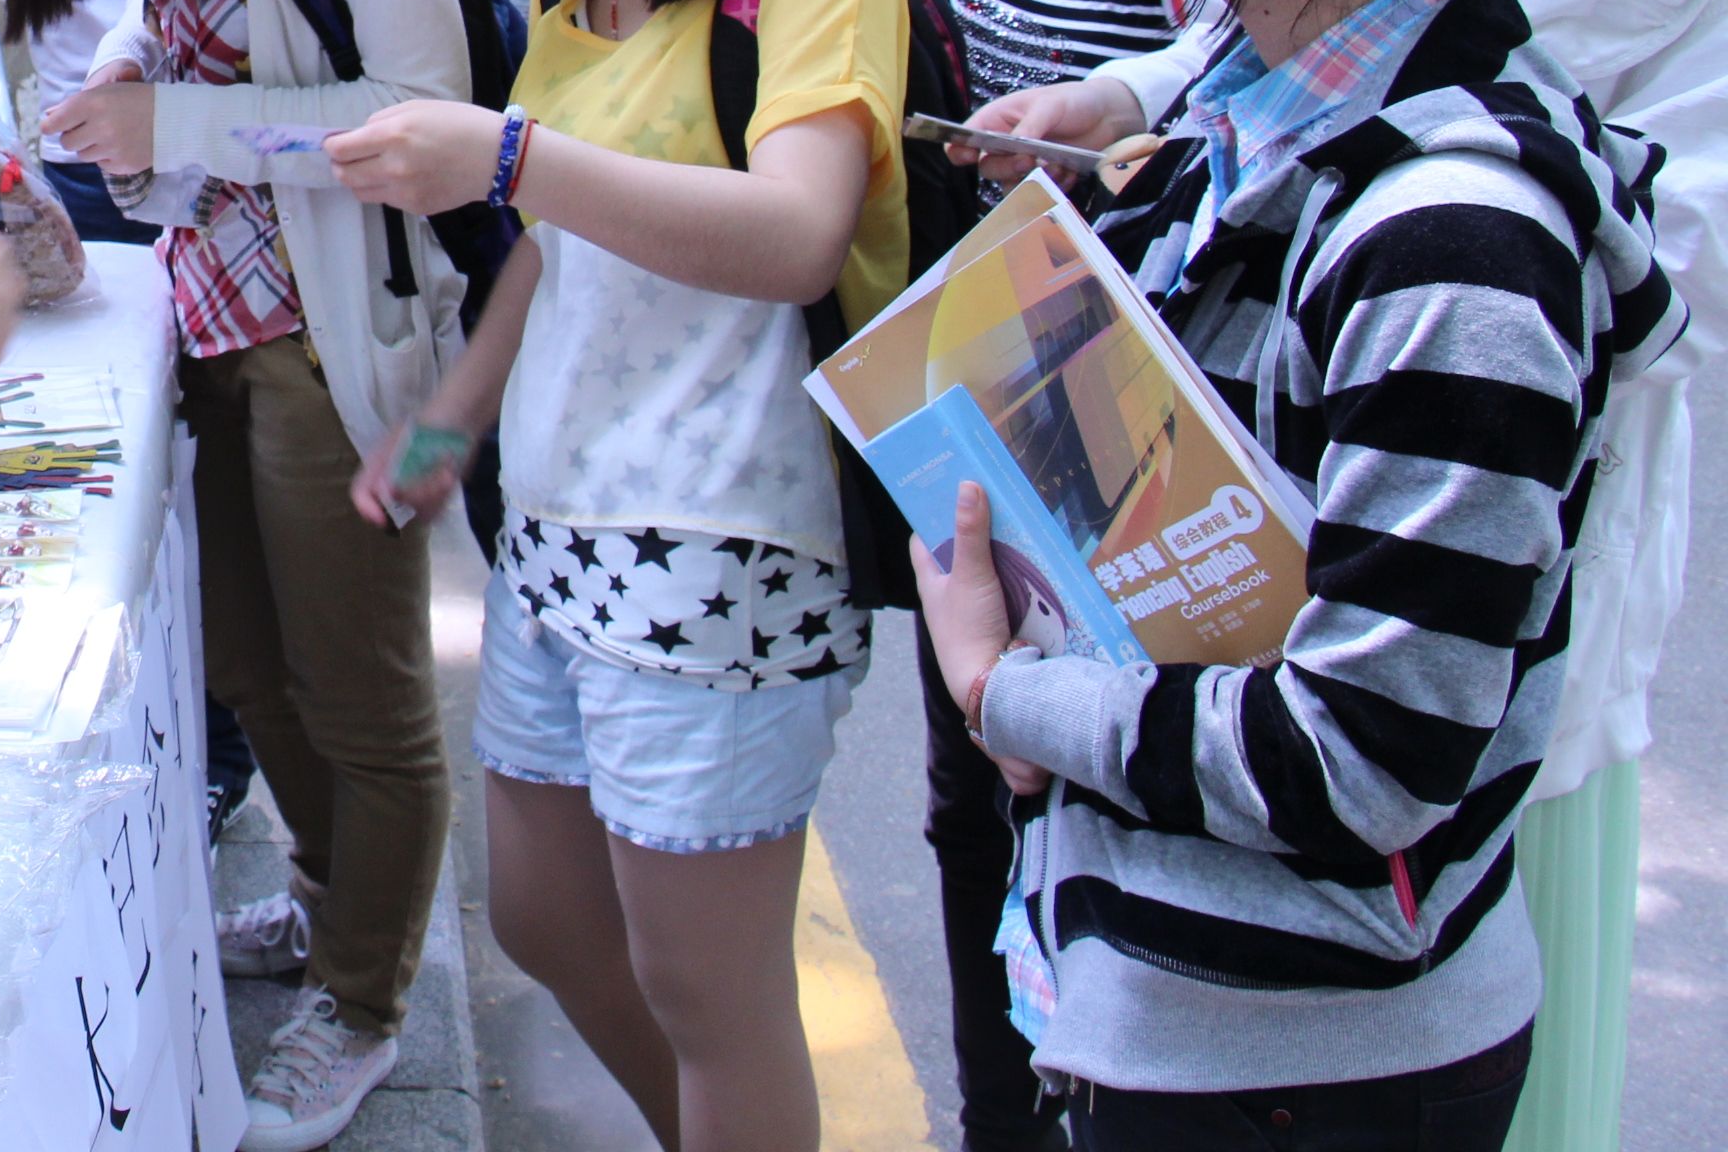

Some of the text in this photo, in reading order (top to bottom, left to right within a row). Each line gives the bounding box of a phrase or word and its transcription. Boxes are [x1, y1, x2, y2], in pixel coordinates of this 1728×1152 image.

[1172, 494, 1253, 551] 综合教程 4
[1178, 539, 1259, 592] English
[1180, 568, 1271, 620] Coursebook
